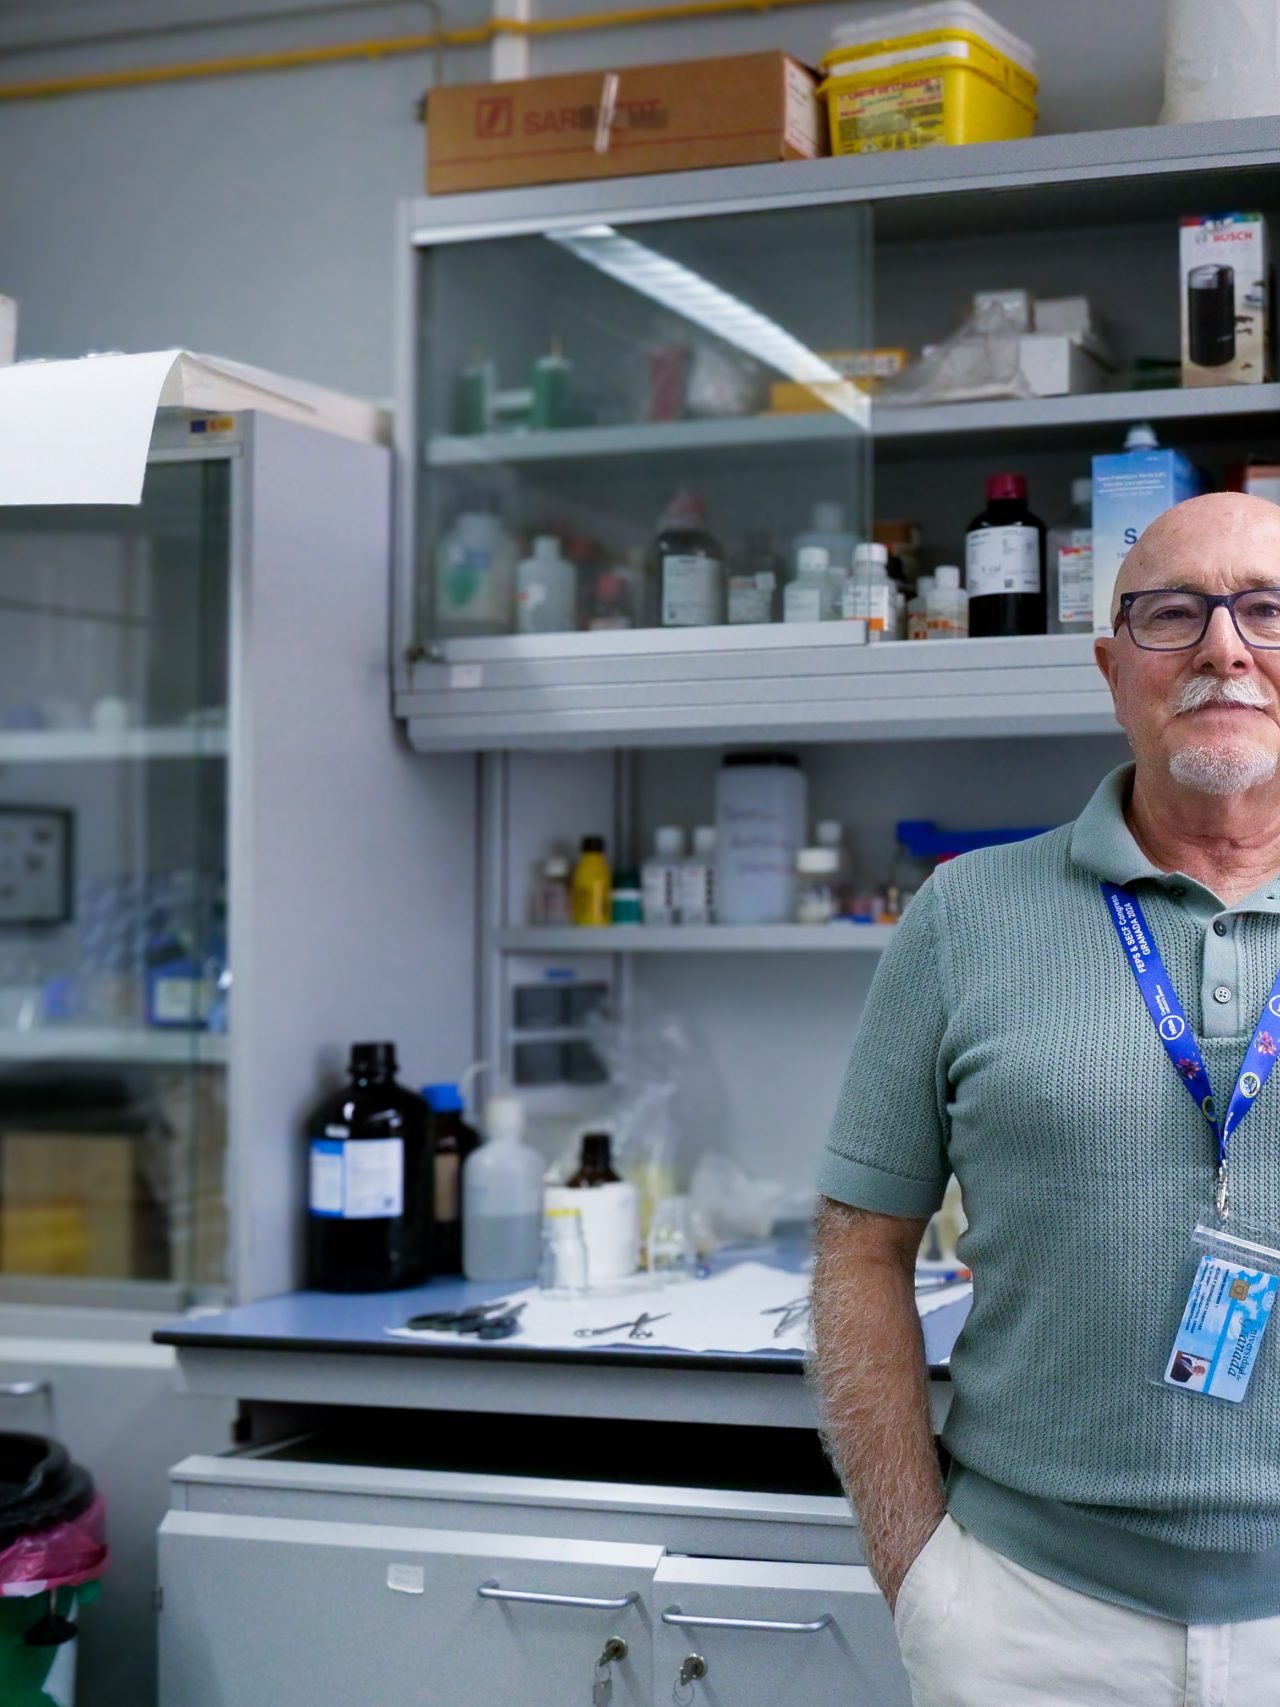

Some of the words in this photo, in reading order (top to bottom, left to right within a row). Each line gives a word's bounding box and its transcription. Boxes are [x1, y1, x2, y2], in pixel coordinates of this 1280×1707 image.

[1111, 894, 1127, 925] Congress
[1127, 902, 1136, 918] 2024
[1122, 926, 1136, 945] SECF
[1131, 918, 1150, 955] GRANADA
[1133, 952, 1147, 973] FEPS
[1228, 1319, 1255, 1377] Granada
[1239, 1321, 1262, 1376] Universidad
